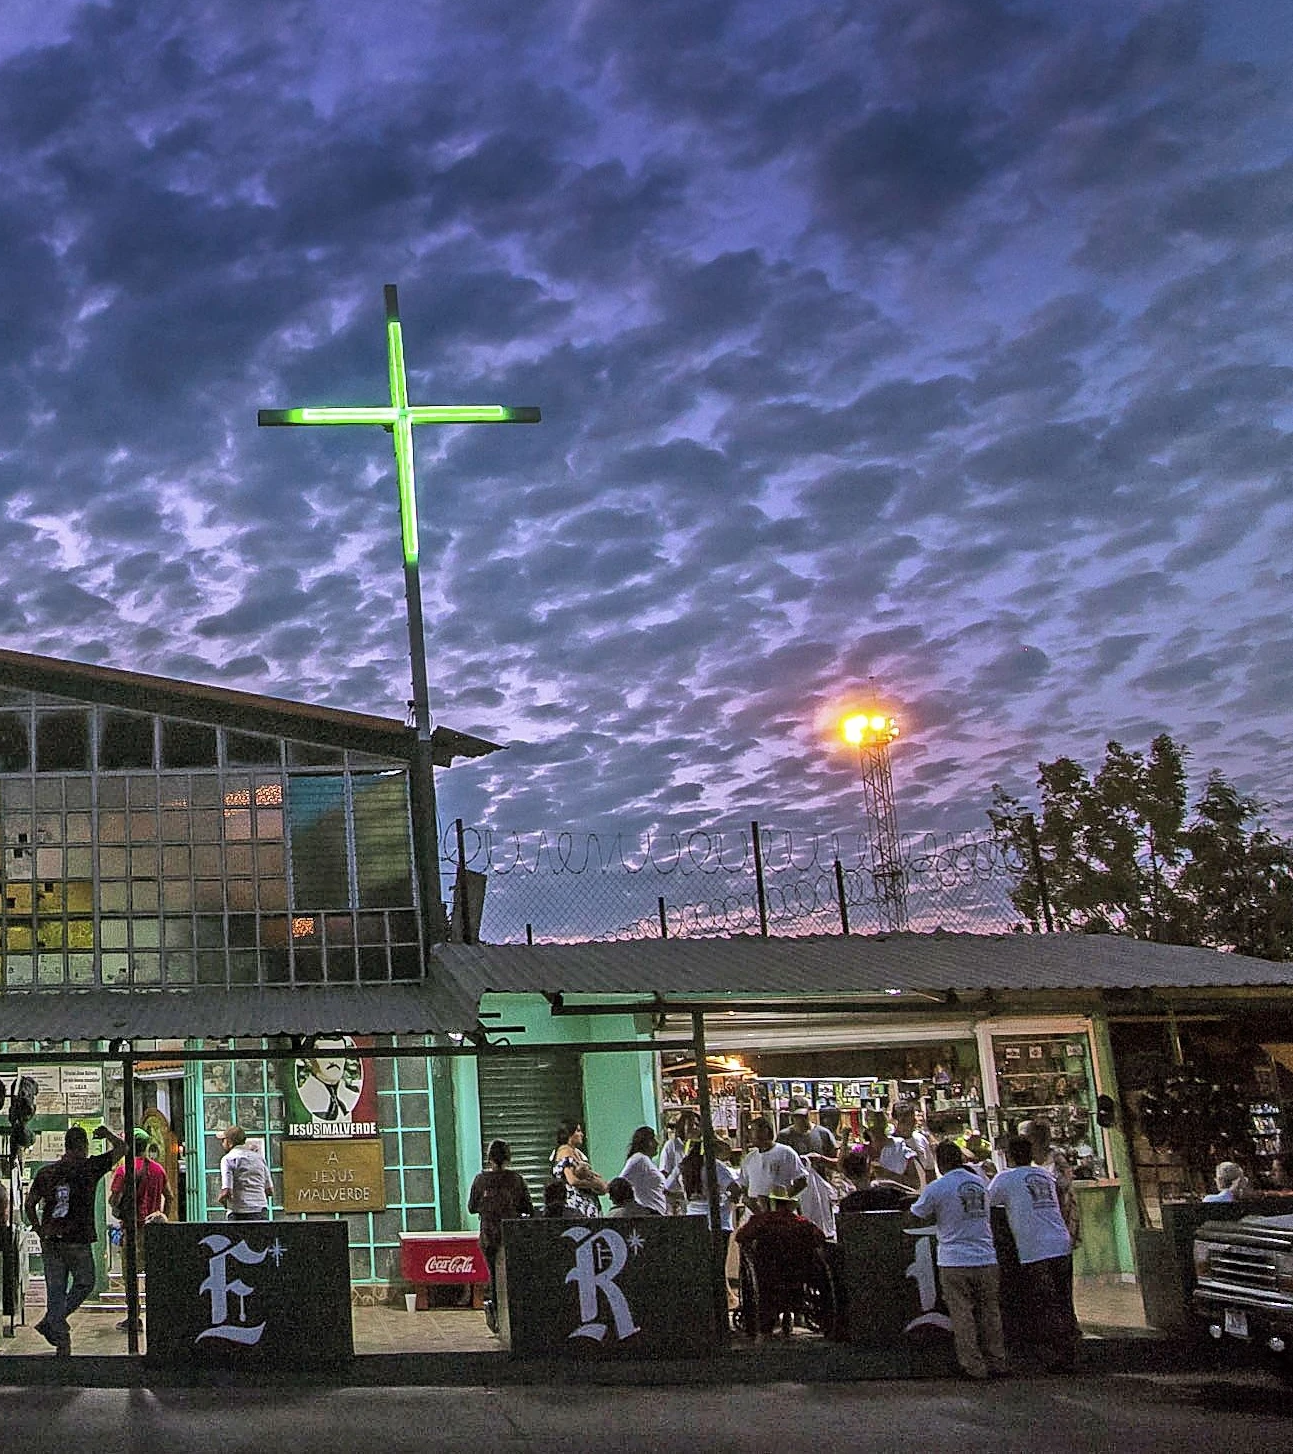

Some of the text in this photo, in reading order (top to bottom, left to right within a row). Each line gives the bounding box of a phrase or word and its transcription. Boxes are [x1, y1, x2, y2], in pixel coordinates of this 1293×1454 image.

[322, 1122, 377, 1135] MALVERDE
[327, 1151, 339, 1165] A
[311, 1169, 356, 1183] JESUS
[298, 1187, 370, 1201] MALVERDE
[560, 1226, 642, 1341] R
